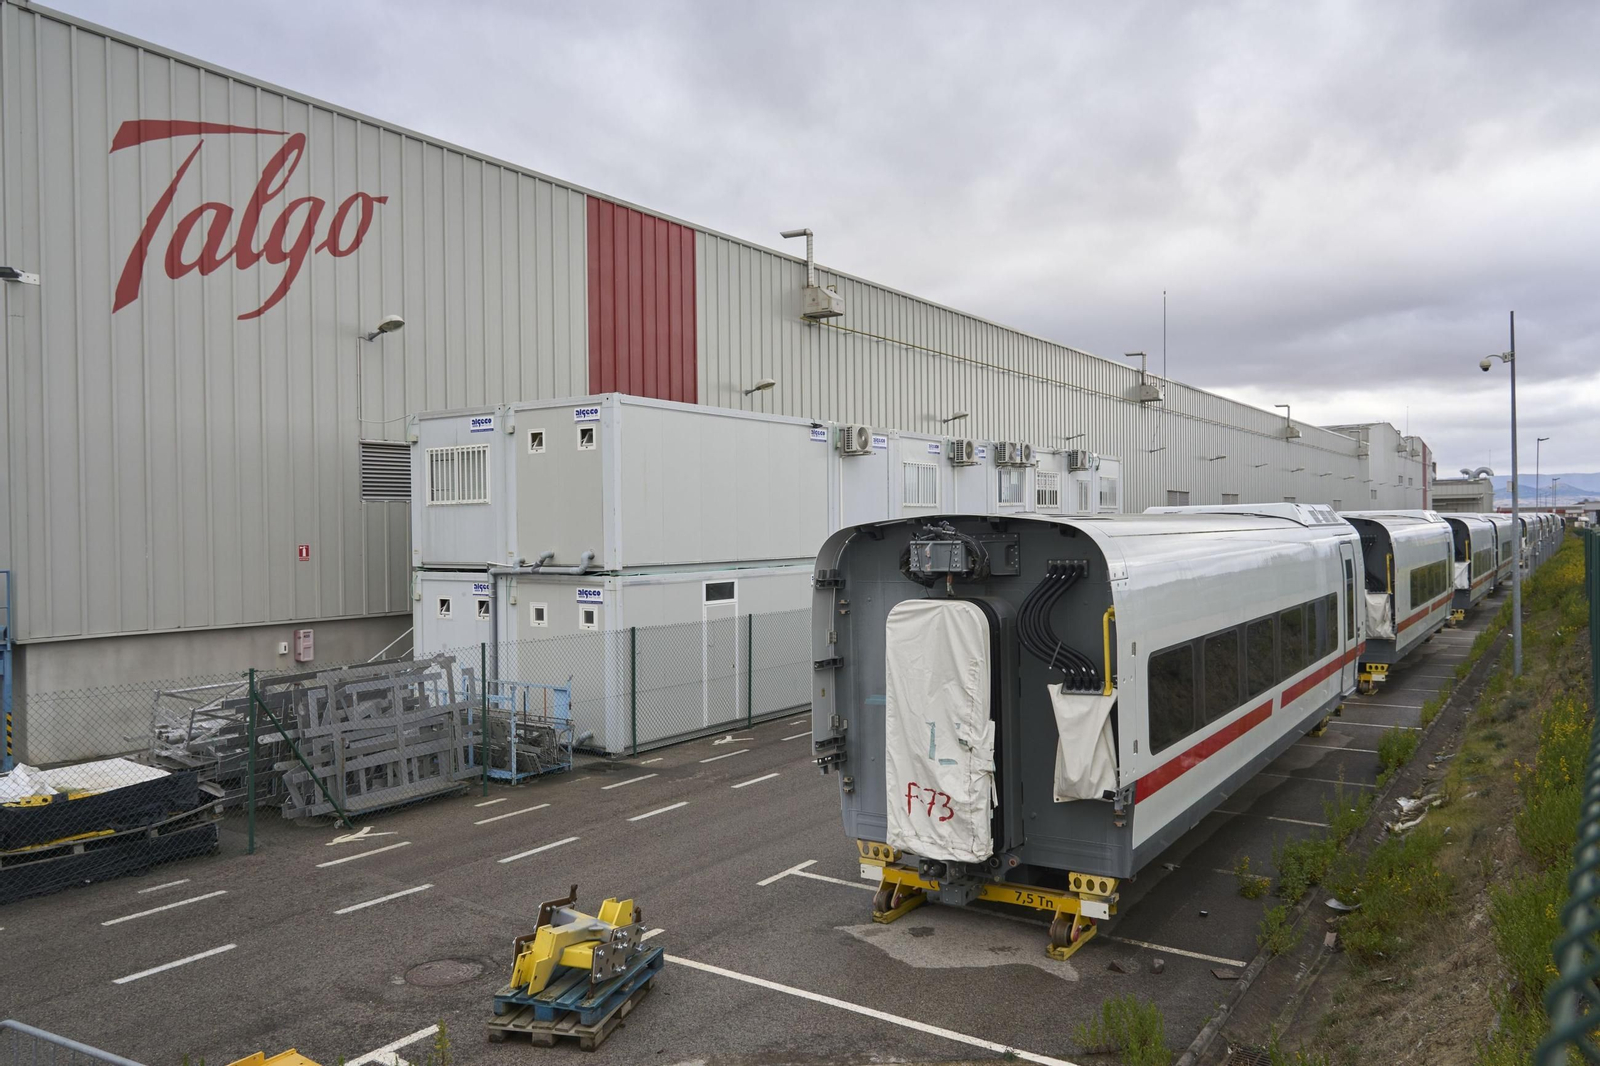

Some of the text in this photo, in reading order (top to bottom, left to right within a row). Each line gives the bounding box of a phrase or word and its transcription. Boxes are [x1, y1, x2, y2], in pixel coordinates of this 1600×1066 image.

[109, 119, 389, 320] Talgo
[1015, 890, 1054, 909] 7,5 Tn
